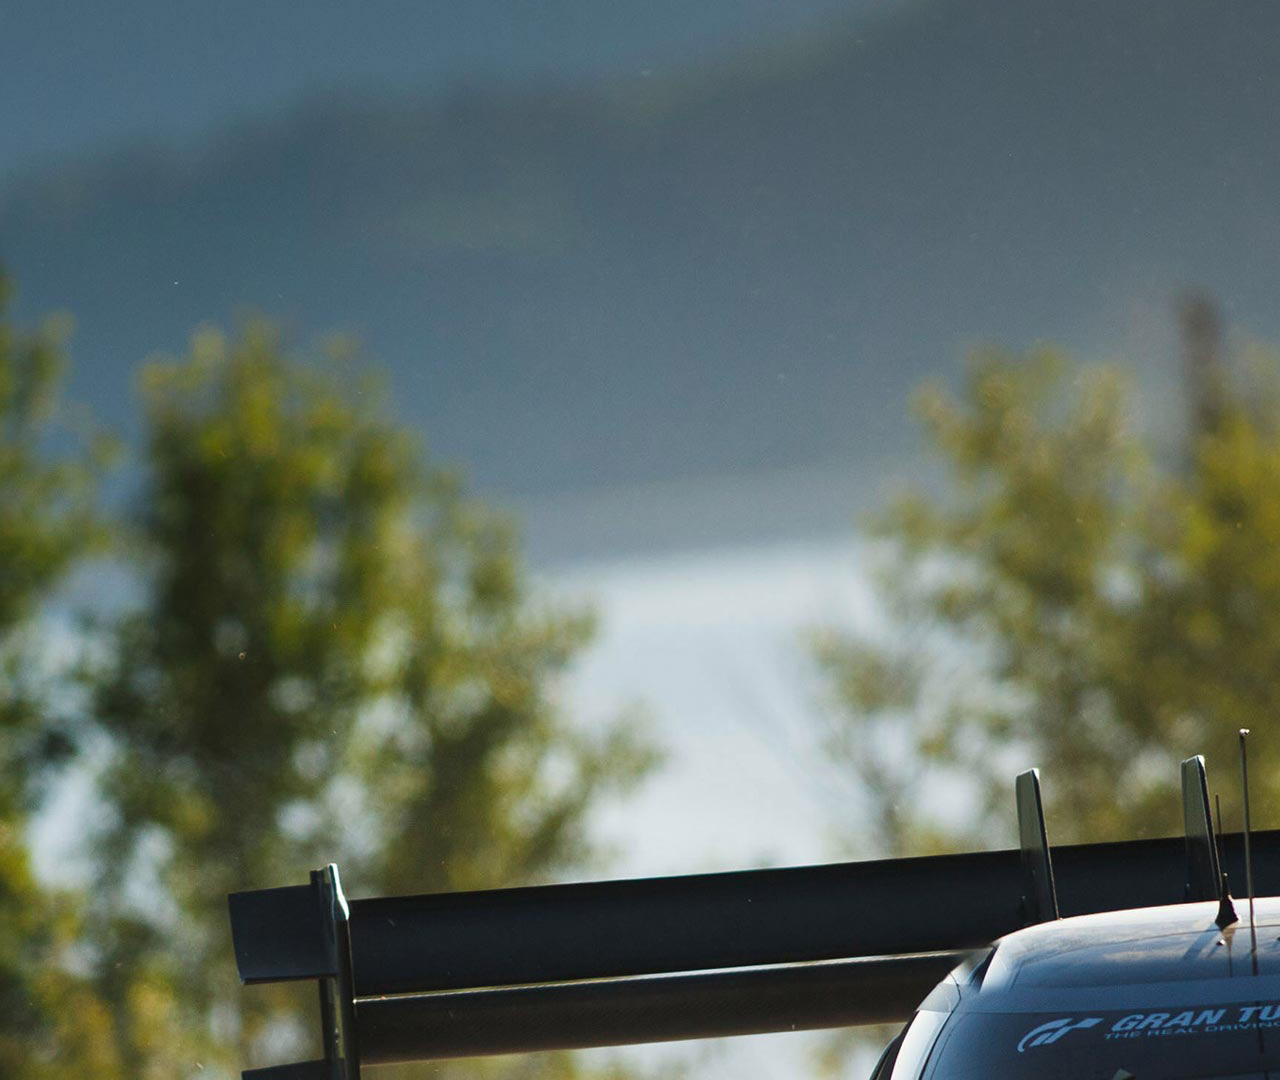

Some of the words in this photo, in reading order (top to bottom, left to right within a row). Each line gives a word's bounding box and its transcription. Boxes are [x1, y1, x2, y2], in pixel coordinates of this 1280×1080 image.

[1111, 1008, 1227, 1032] GRAN
[1103, 1032, 1142, 1040] THE
[1147, 1027, 1194, 1037] REAL
